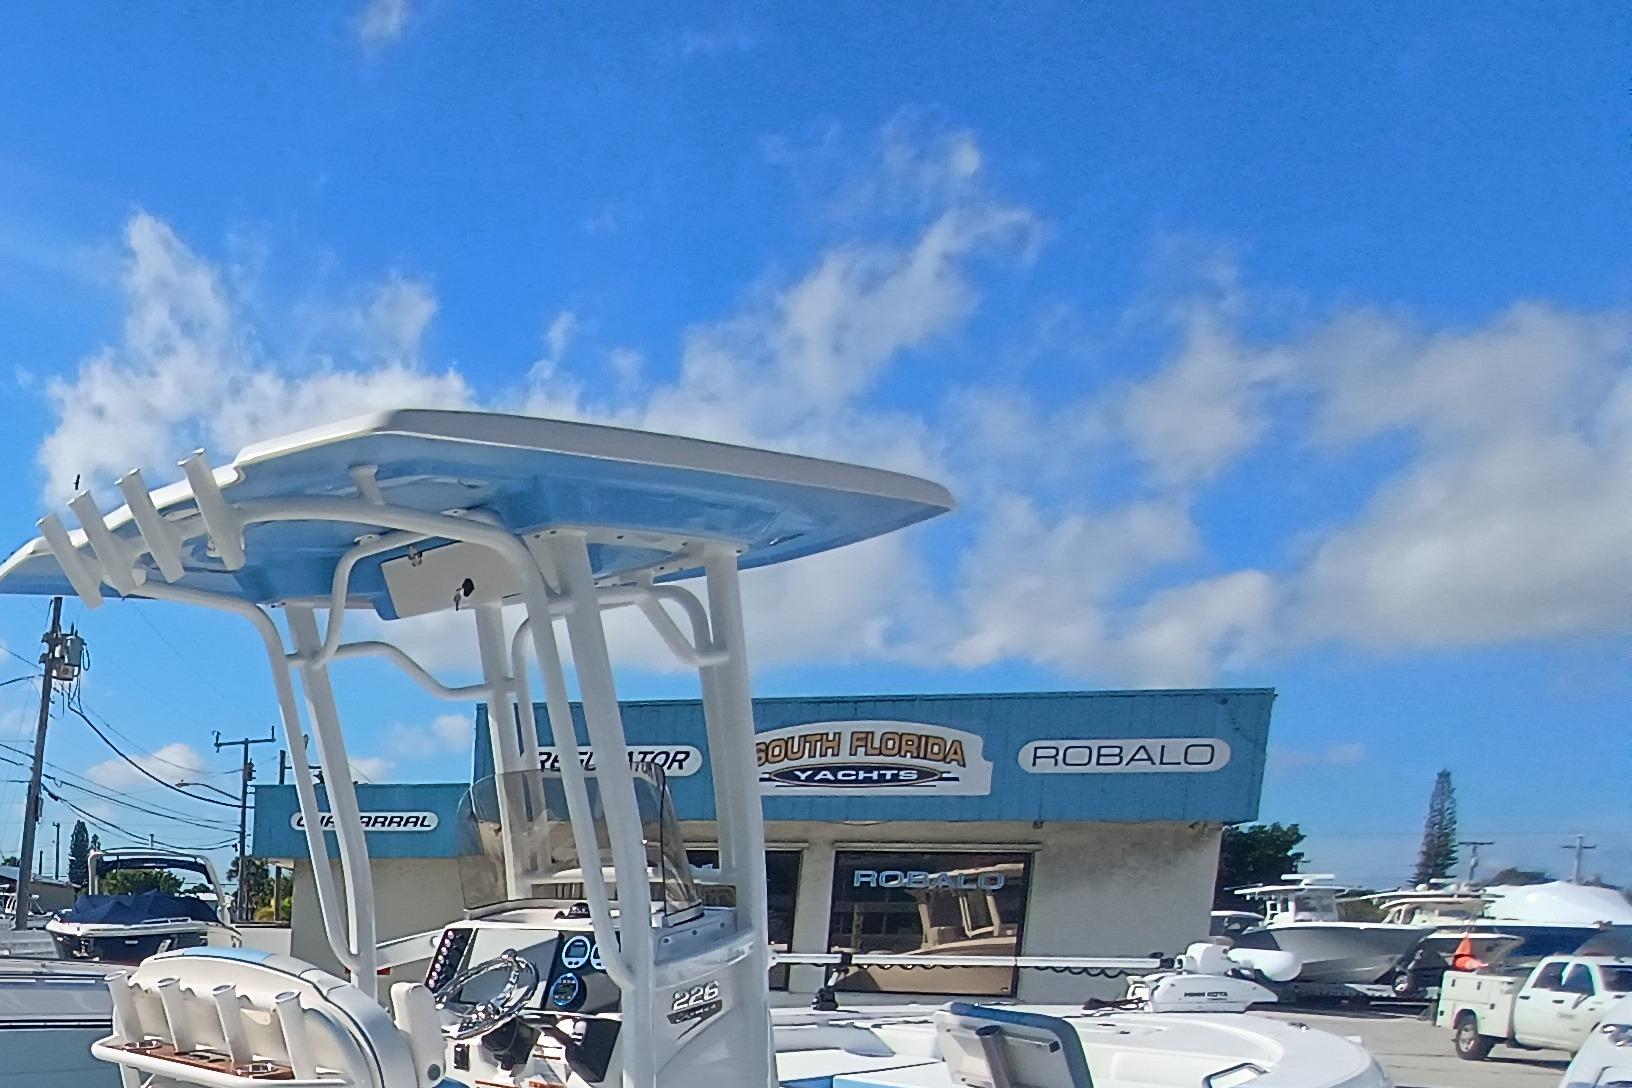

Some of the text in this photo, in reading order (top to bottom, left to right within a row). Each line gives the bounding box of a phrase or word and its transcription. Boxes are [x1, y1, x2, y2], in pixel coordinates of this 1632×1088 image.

[756, 730, 967, 769] SOUTH FLORIDA
[1031, 743, 1216, 768] ROBALO
[538, 750, 691, 773] REUTOR
[792, 769, 919, 782] YACHTS
[296, 814, 433, 828] CAARRAL
[853, 869, 1006, 890] ROBALO
[671, 979, 721, 1012] 226
